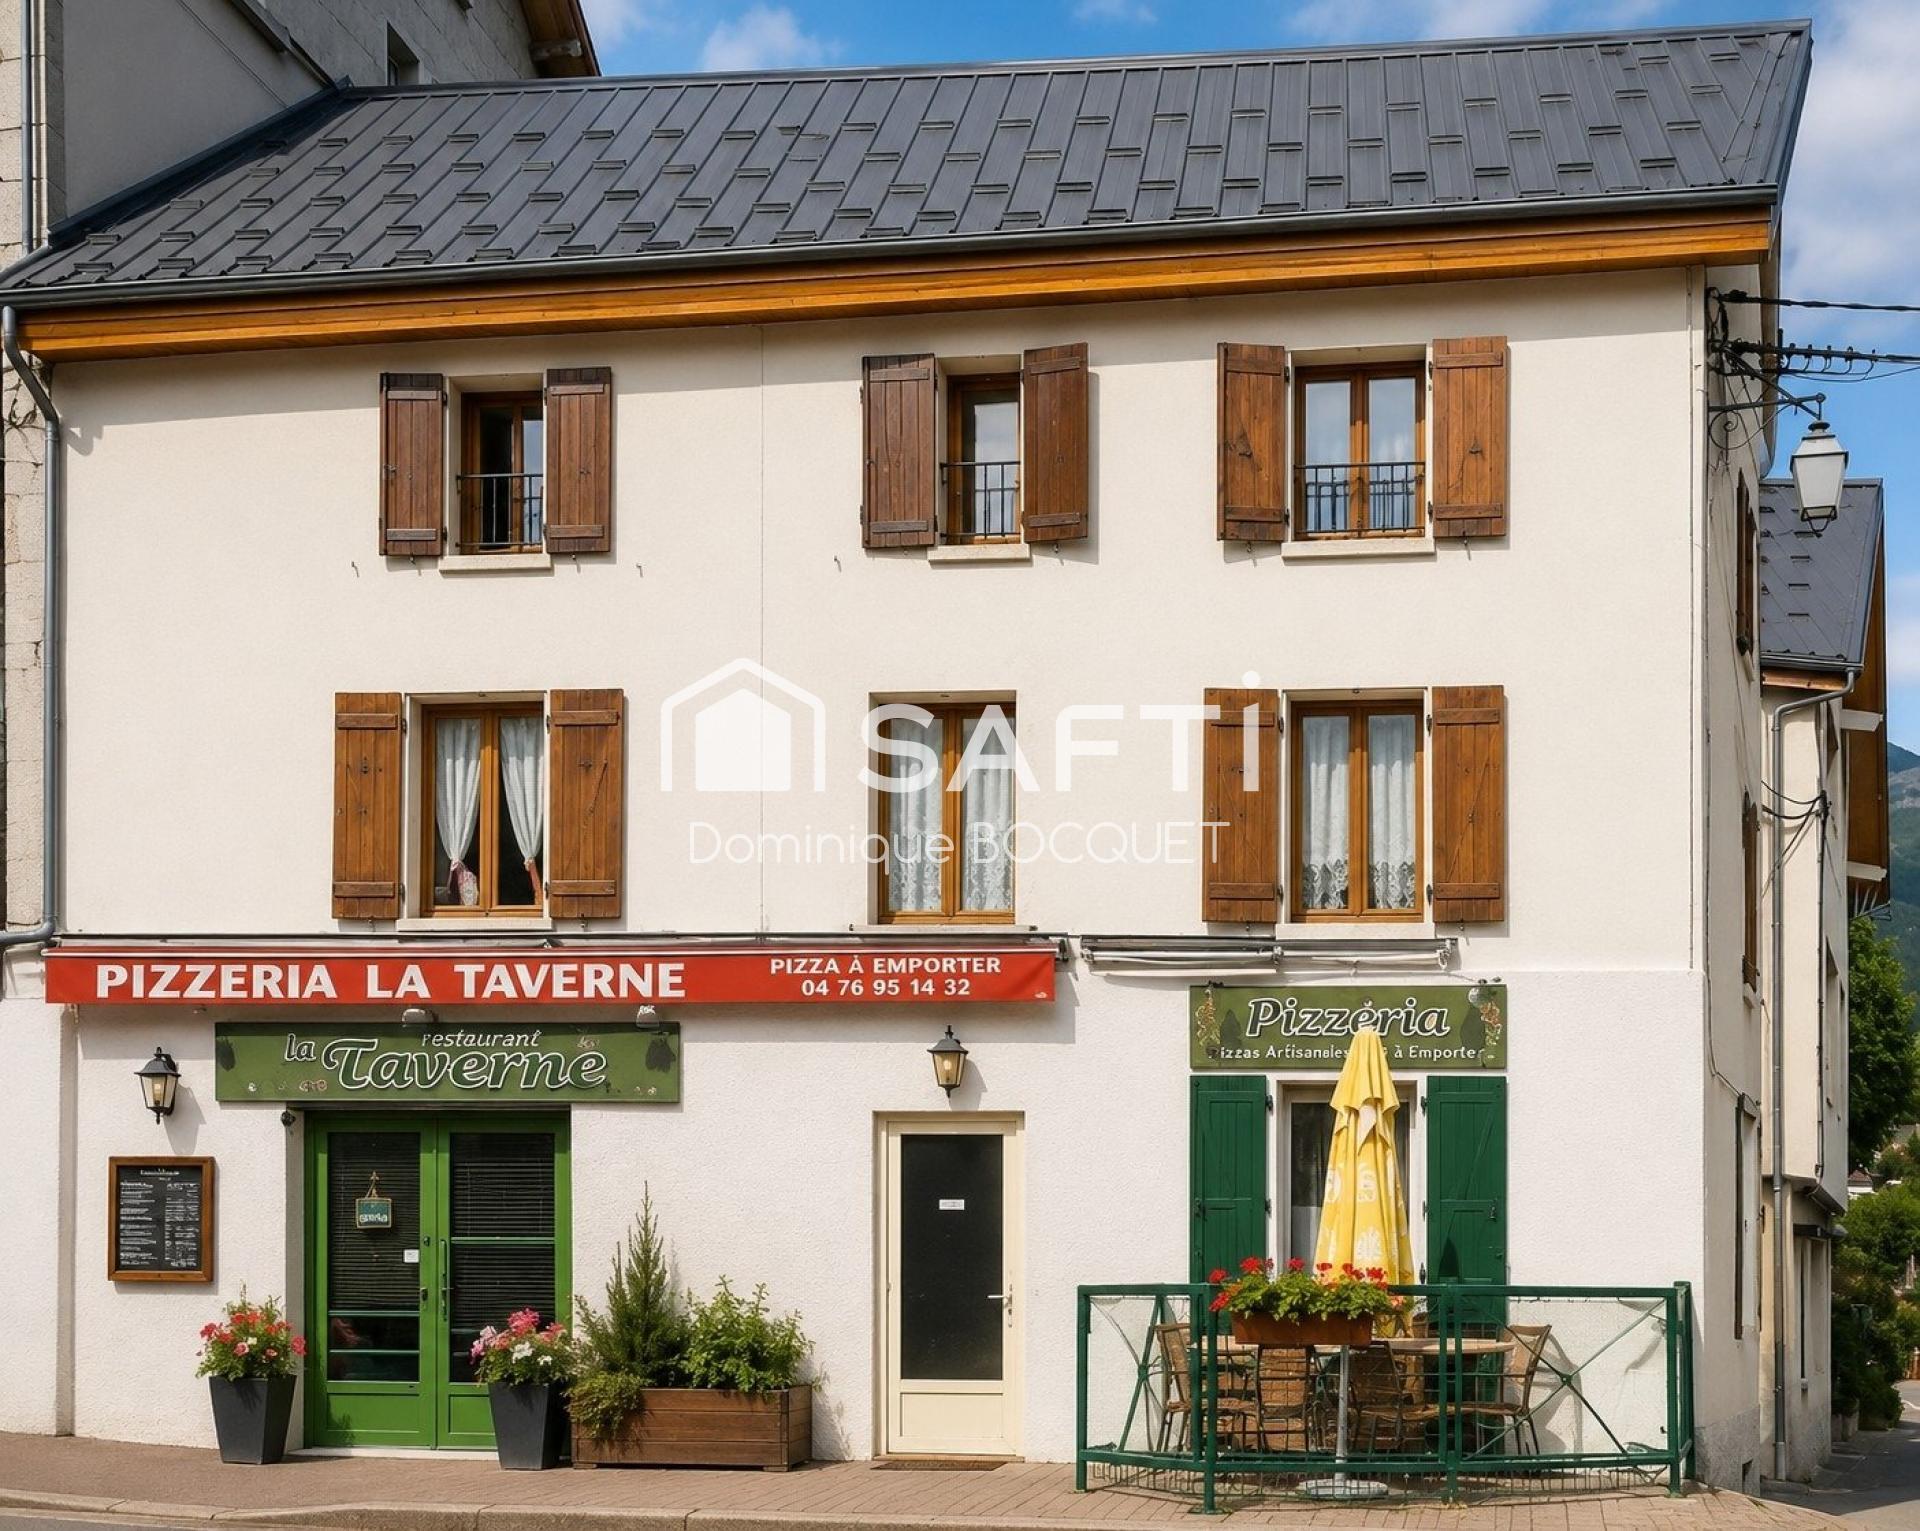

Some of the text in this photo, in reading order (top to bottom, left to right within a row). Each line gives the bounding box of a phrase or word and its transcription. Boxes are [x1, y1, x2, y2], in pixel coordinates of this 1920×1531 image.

[770, 955, 1001, 975] PIZZA À EMPORTER
[95, 962, 687, 999] PIZZERIA LA TAVERNE
[801, 978, 970, 996] 04 76 95 14 32
[421, 1029, 543, 1047] restaurant
[1394, 1044, 1403, 1059] à
[284, 1033, 608, 1090] la Taverne
